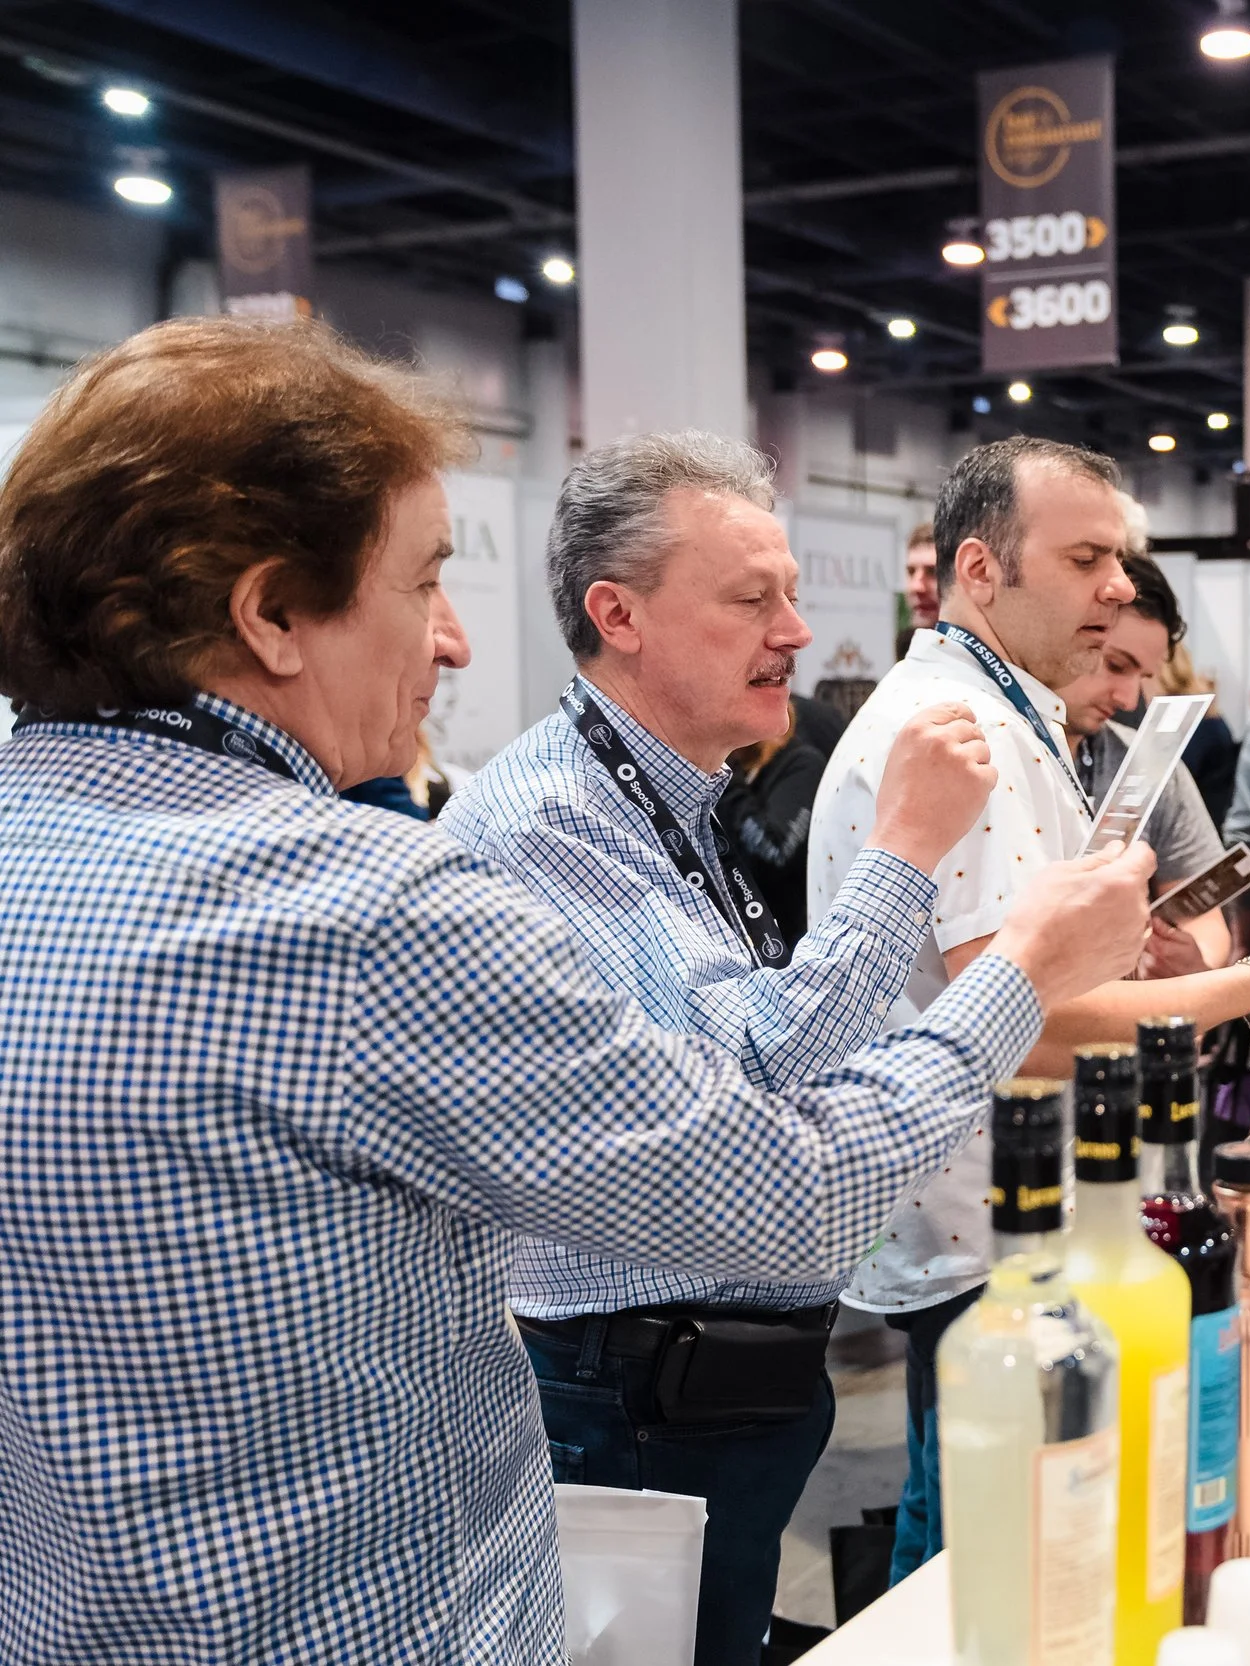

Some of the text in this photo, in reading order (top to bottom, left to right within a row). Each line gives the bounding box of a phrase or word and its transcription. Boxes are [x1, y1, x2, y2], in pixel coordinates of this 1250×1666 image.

[985, 210, 1086, 262] 3500
[1009, 279, 1111, 330] 3600
[946, 626, 1013, 688] BELLISSIMO
[130, 707, 193, 731] potOn
[630, 781, 657, 816] SpotOn
[732, 867, 754, 902] SpotOn
